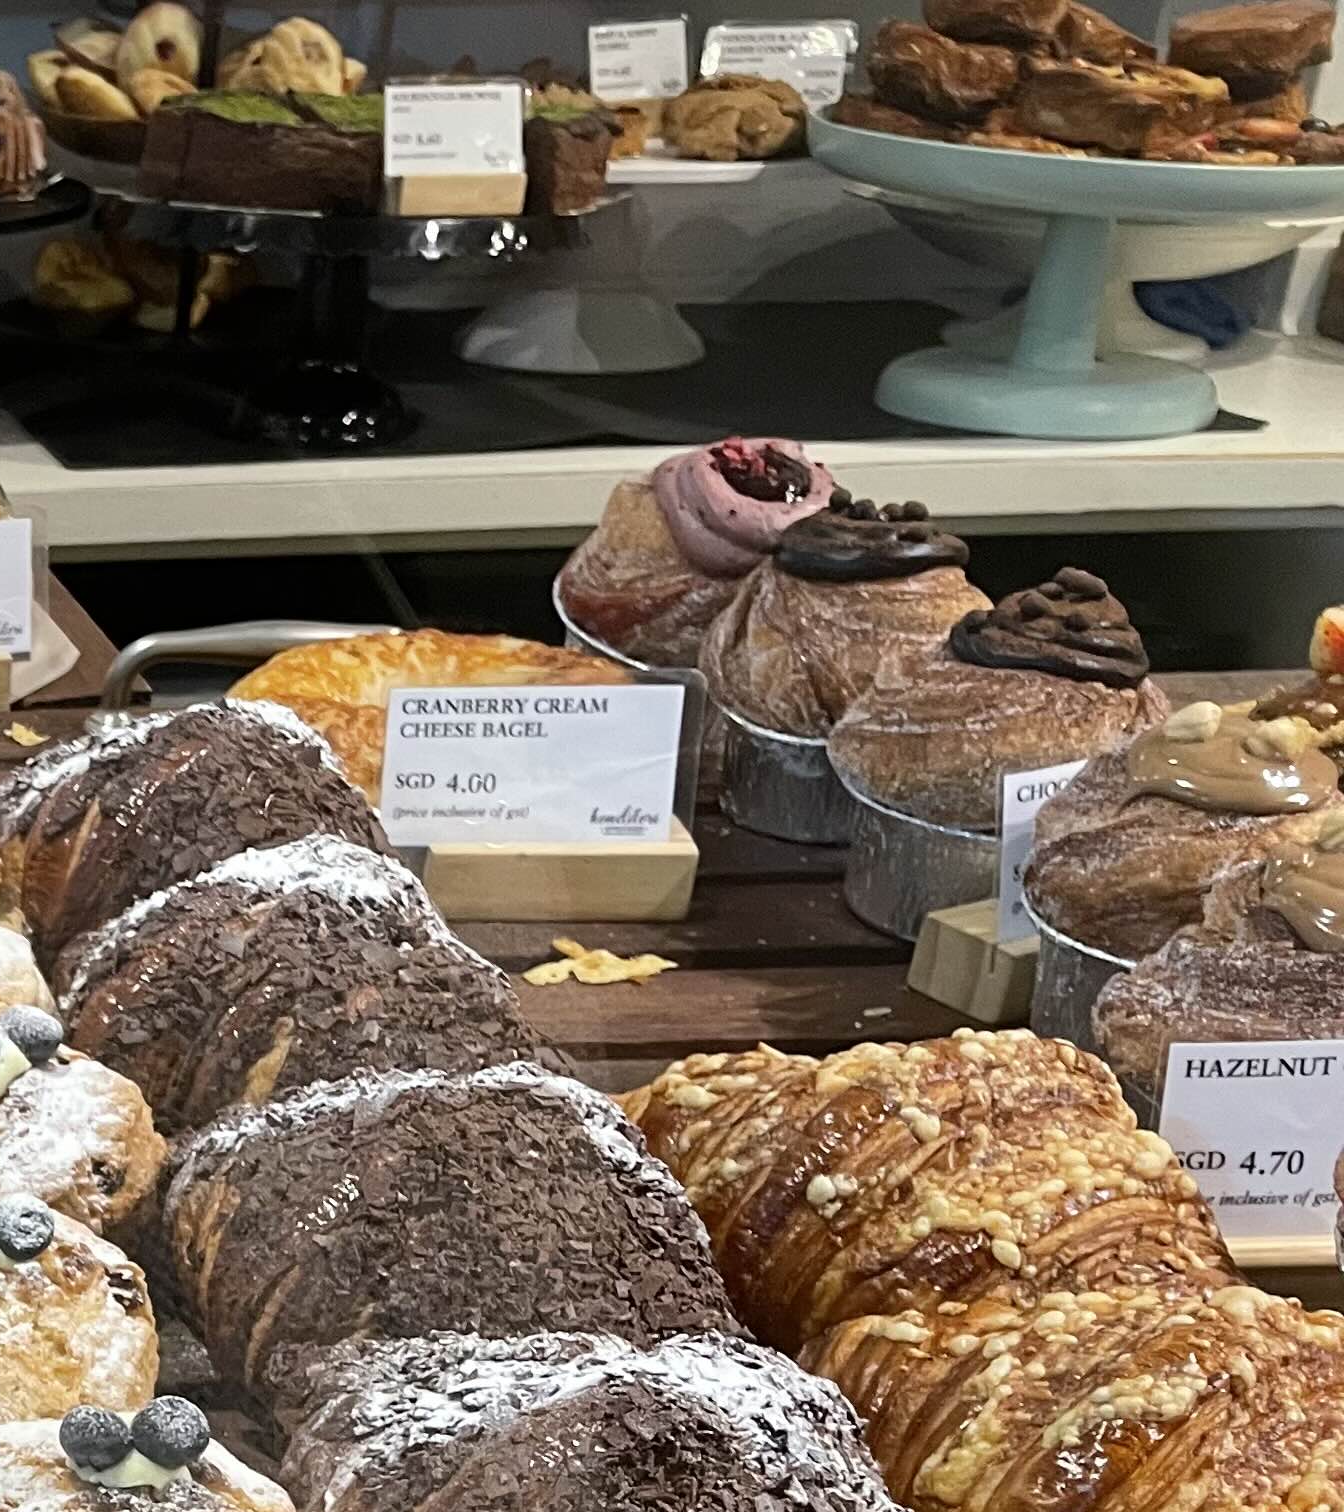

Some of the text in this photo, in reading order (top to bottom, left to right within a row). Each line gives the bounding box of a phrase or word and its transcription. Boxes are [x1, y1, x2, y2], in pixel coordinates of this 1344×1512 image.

[401, 697, 610, 715] CRANBERRY CREAM
[399, 721, 549, 739] CHEESE BAGEL
[394, 773, 497, 794] SGD 4.00
[1184, 1056, 1338, 1079] HAZELNUT
[1238, 1149, 1306, 1176] 4.70
